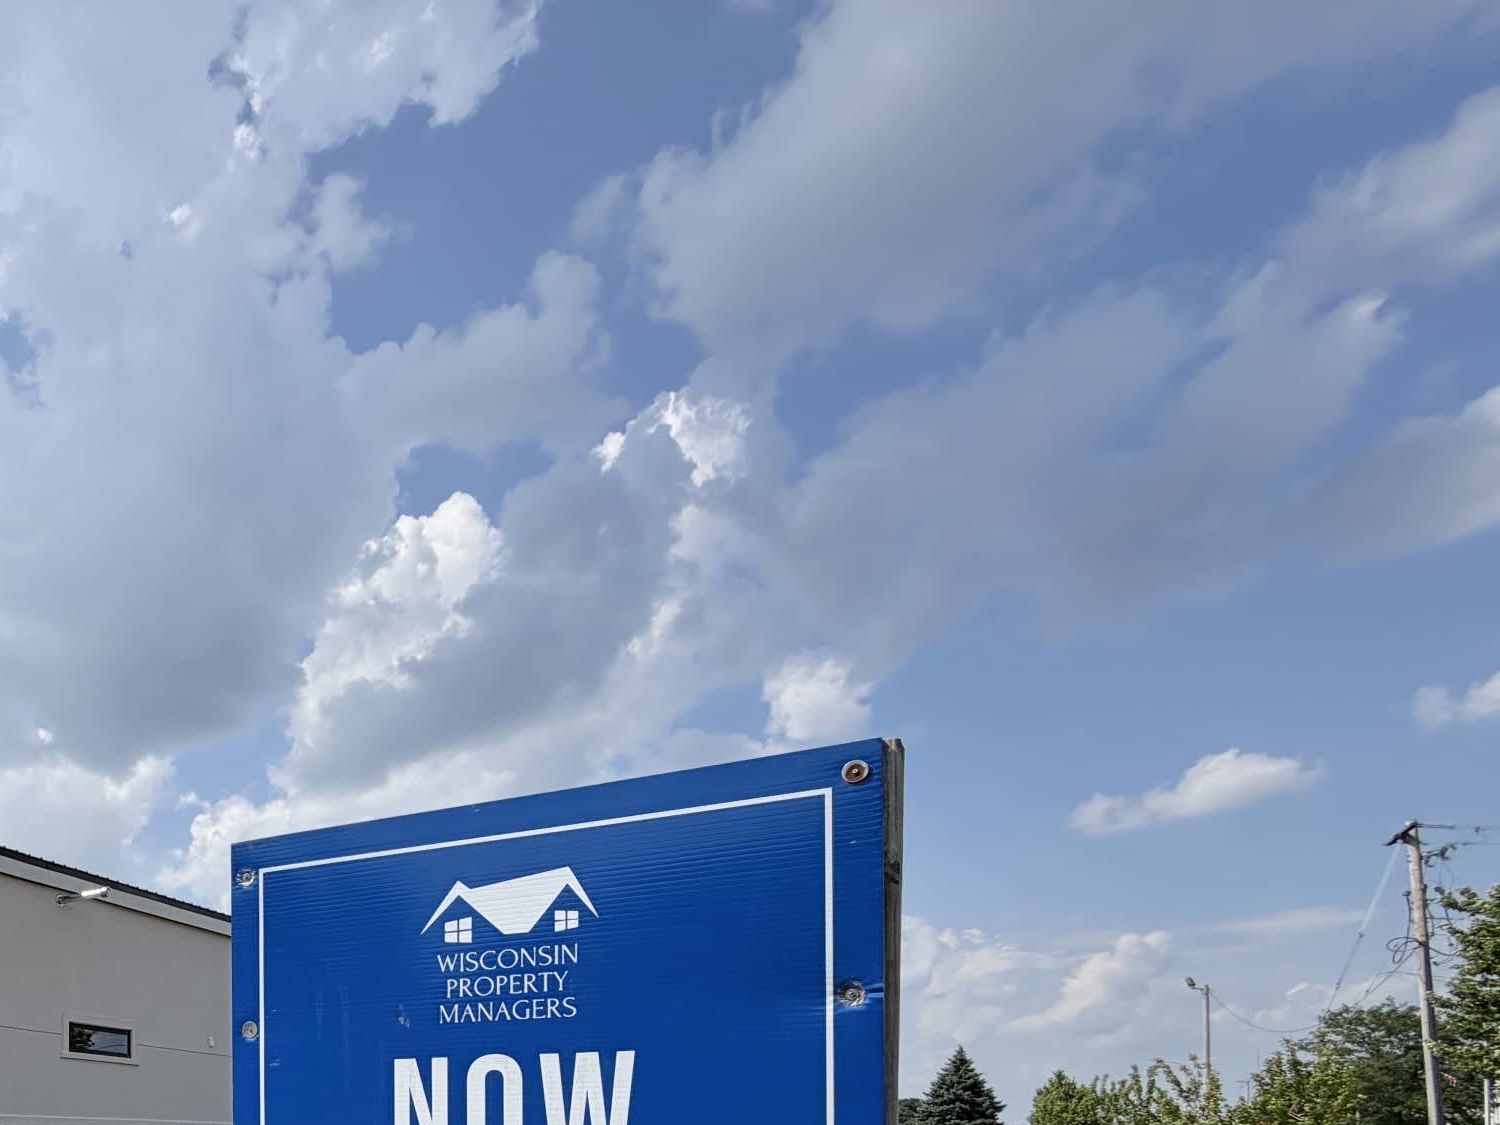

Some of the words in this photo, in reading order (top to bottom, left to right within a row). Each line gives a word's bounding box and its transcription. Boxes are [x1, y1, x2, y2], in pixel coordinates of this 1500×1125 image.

[437, 943, 578, 972] WISCONSIN
[446, 970, 568, 999] PROPERTY
[439, 996, 577, 1024] MANAGERS
